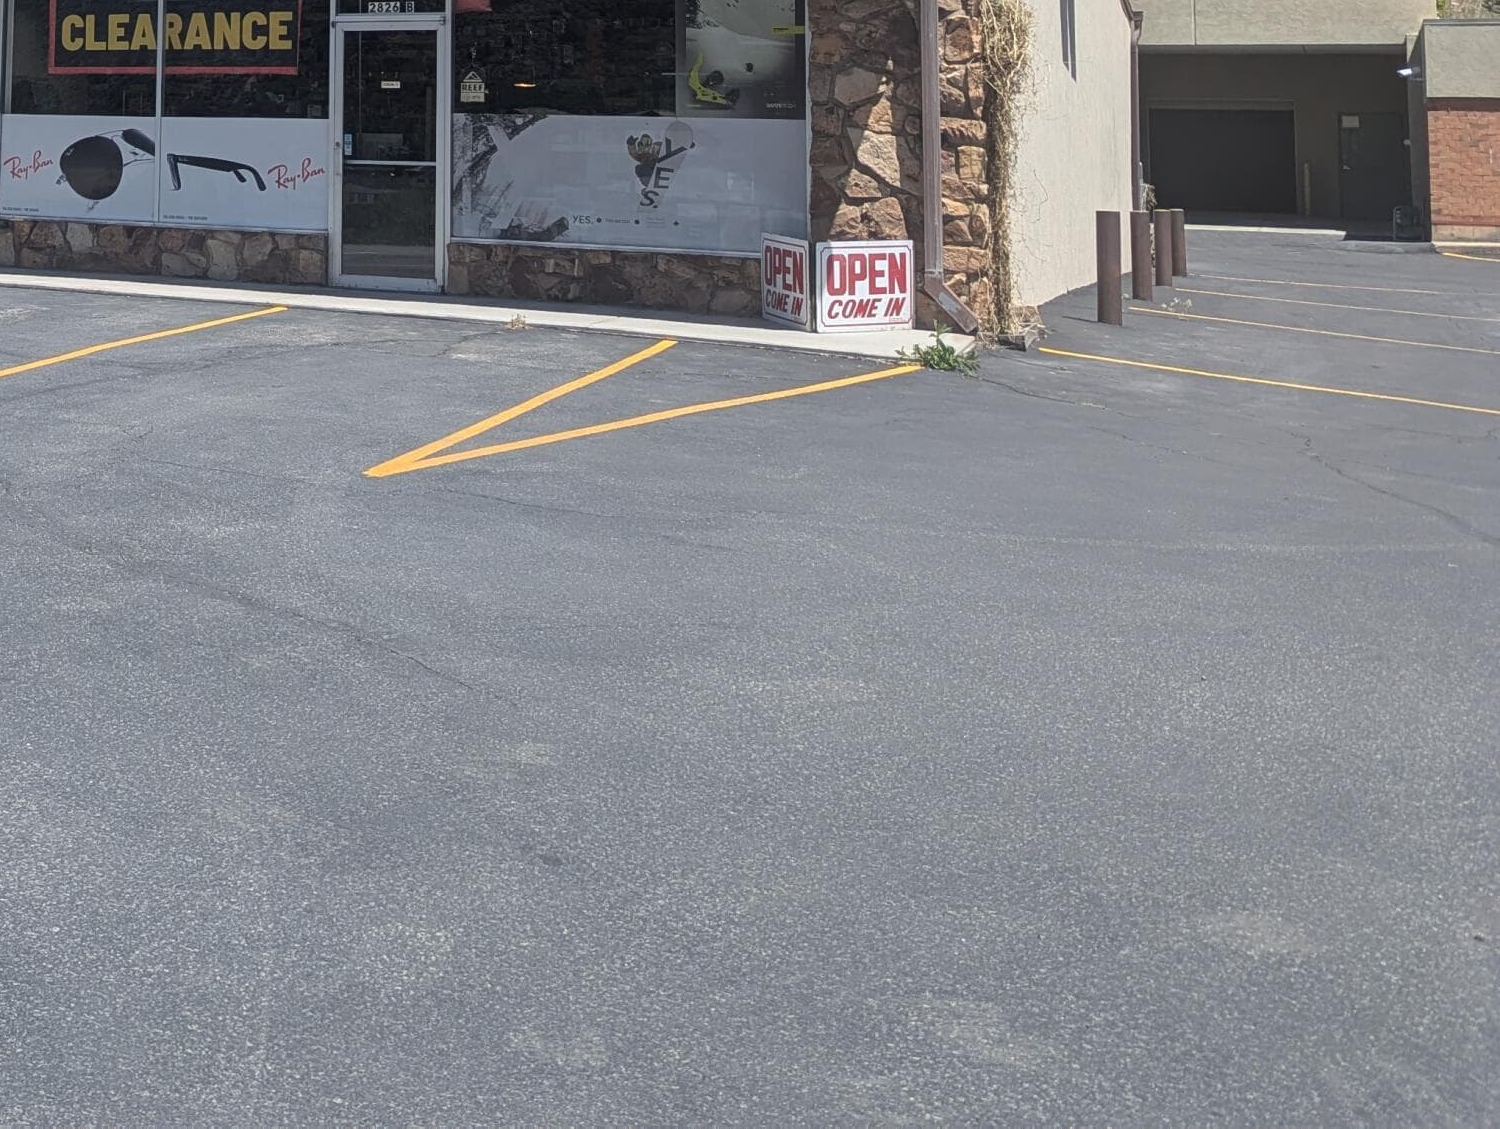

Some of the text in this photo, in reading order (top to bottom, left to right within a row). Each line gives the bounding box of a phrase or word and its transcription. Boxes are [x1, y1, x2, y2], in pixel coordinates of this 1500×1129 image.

[369, 2, 400, 13] 2826
[61, 11, 293, 51] CLEARANCE
[462, 84, 483, 92] REEF
[764, 245, 804, 295] OPEN
[826, 252, 907, 296] OPEN
[765, 289, 803, 316] COME IN
[827, 297, 906, 319] COME IN
